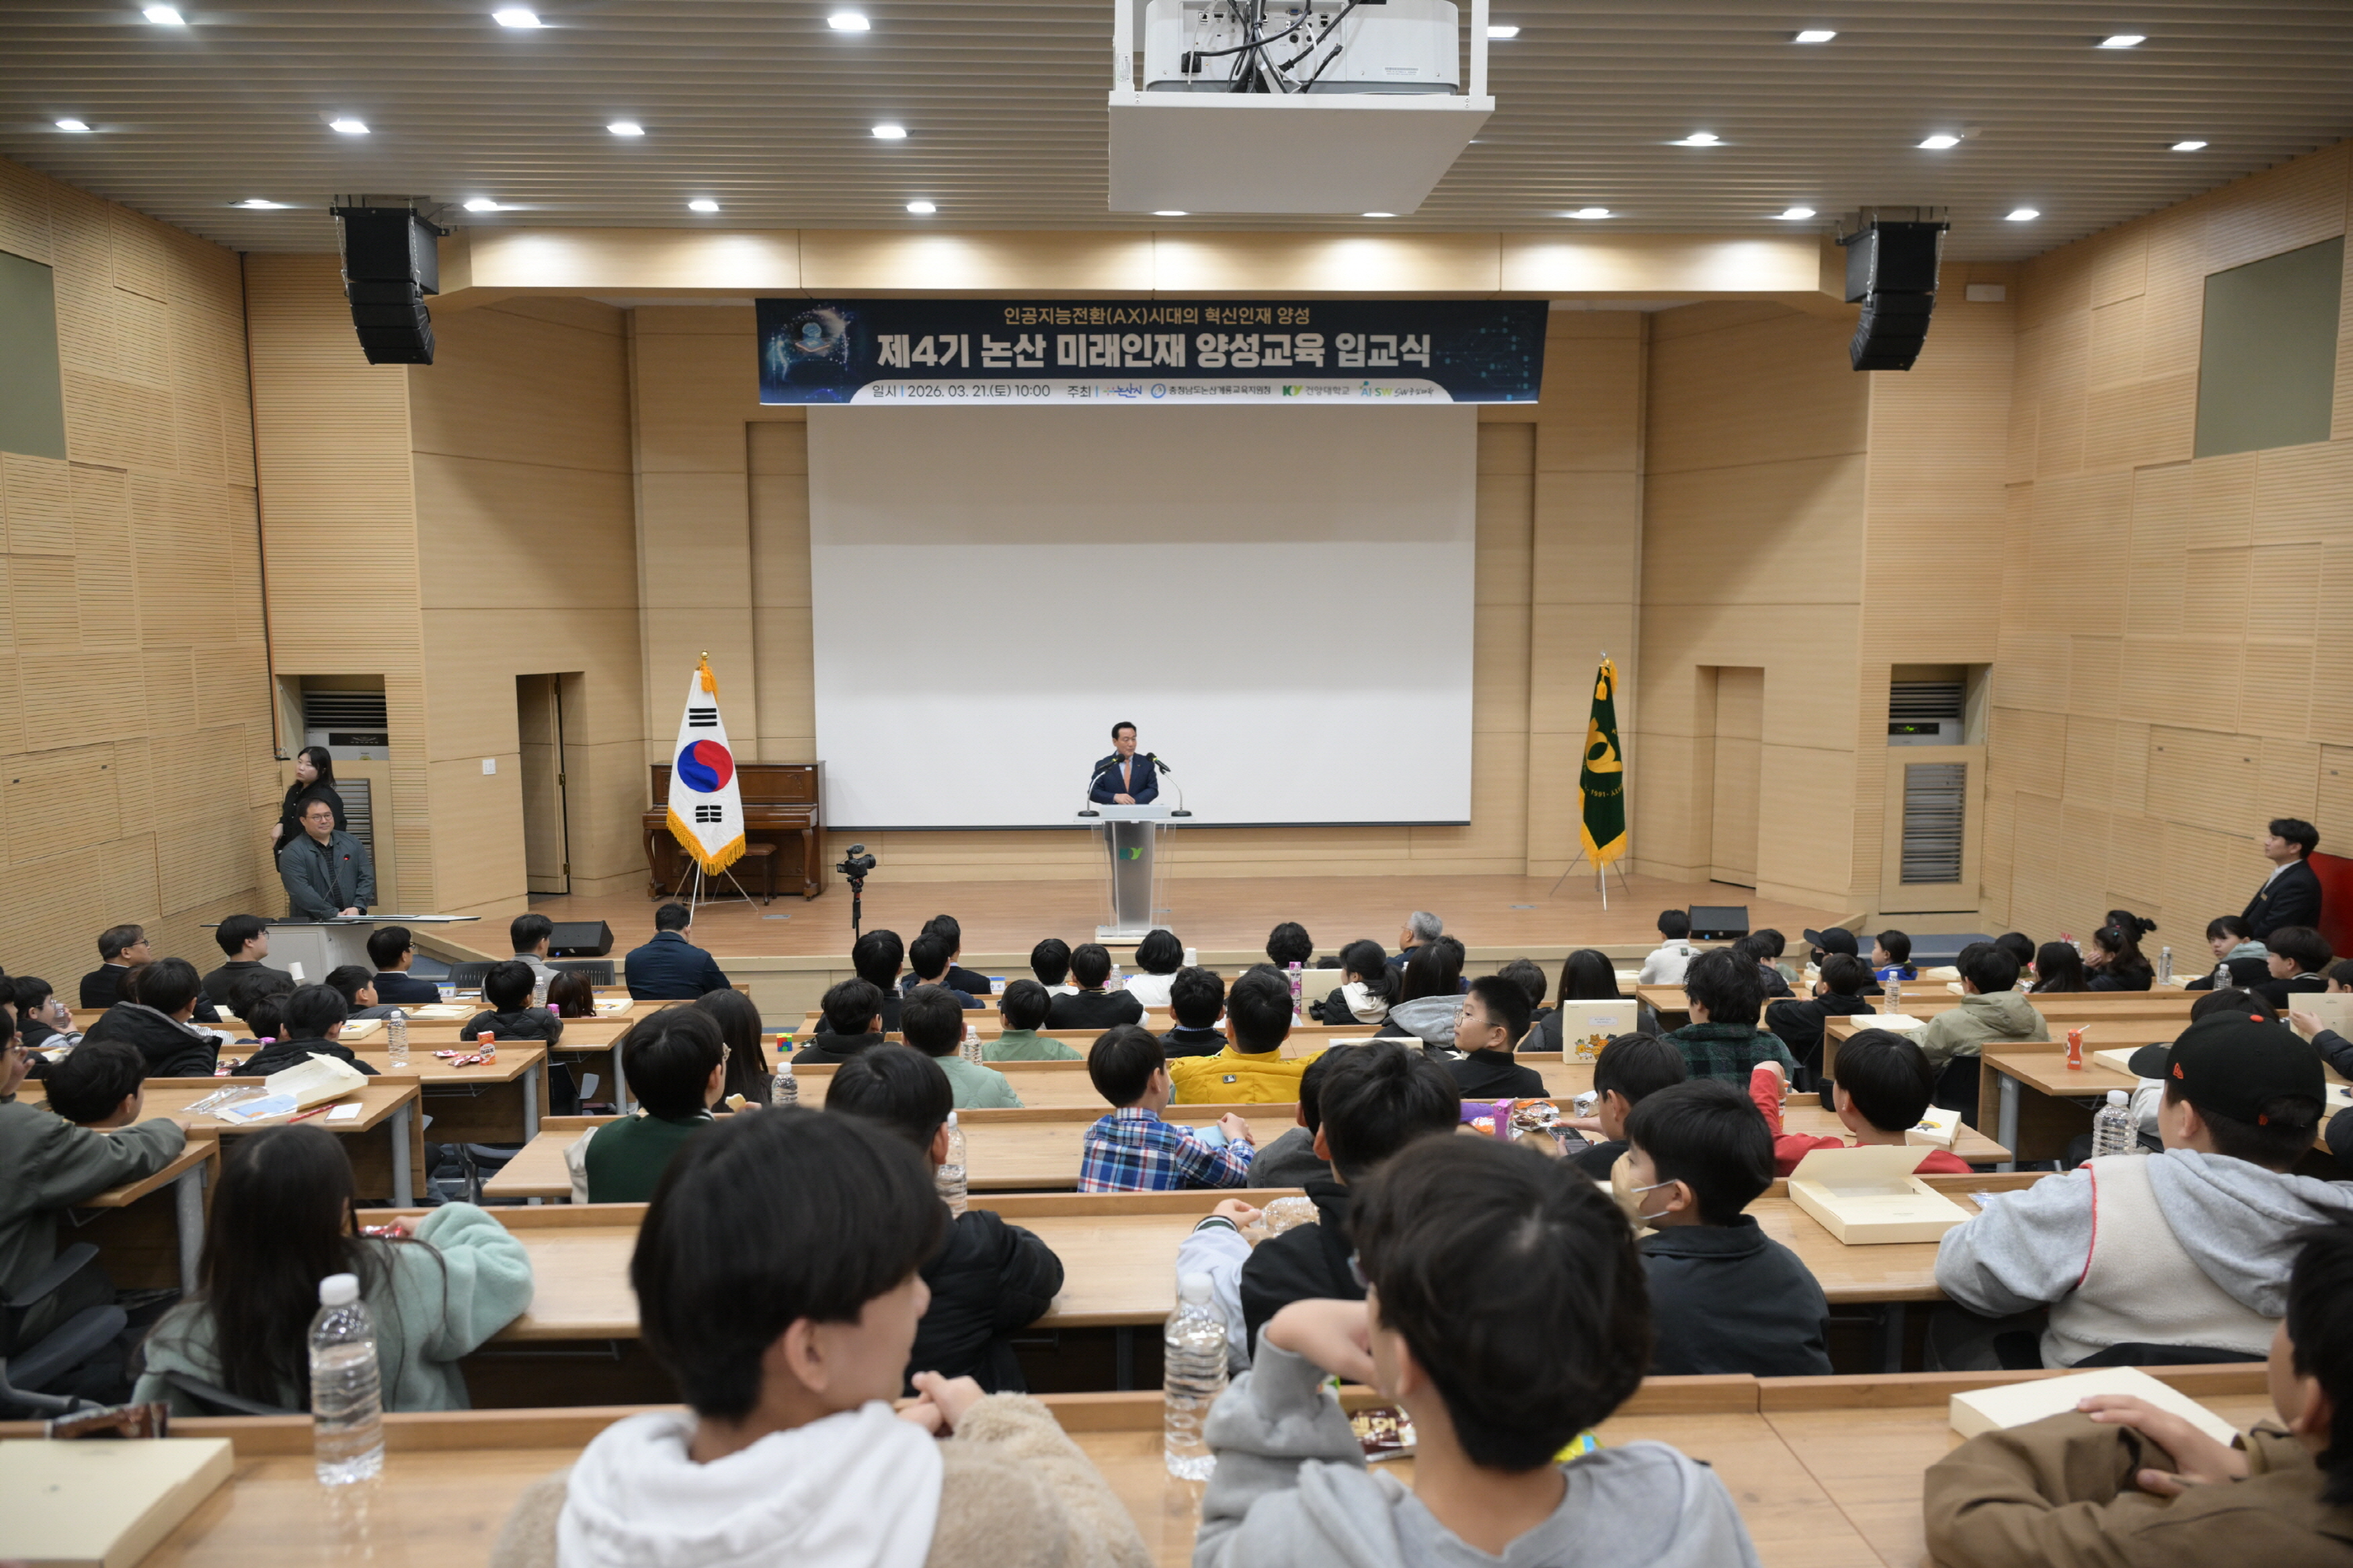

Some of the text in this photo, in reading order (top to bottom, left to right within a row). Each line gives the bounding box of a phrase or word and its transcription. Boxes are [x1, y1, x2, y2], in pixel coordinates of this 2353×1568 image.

[1004, 307, 1310, 325] 인공지능전환(AX)시대의 혁신인재 양성
[877, 333, 1431, 368] 제4기 논산 미래인재 양성교육 입교식
[872, 384, 1051, 399] 일시 2026. 03. 21.(토) 10:00
[1067, 385, 1092, 399] 주최
[1306, 386, 1350, 395] 건양대학교
